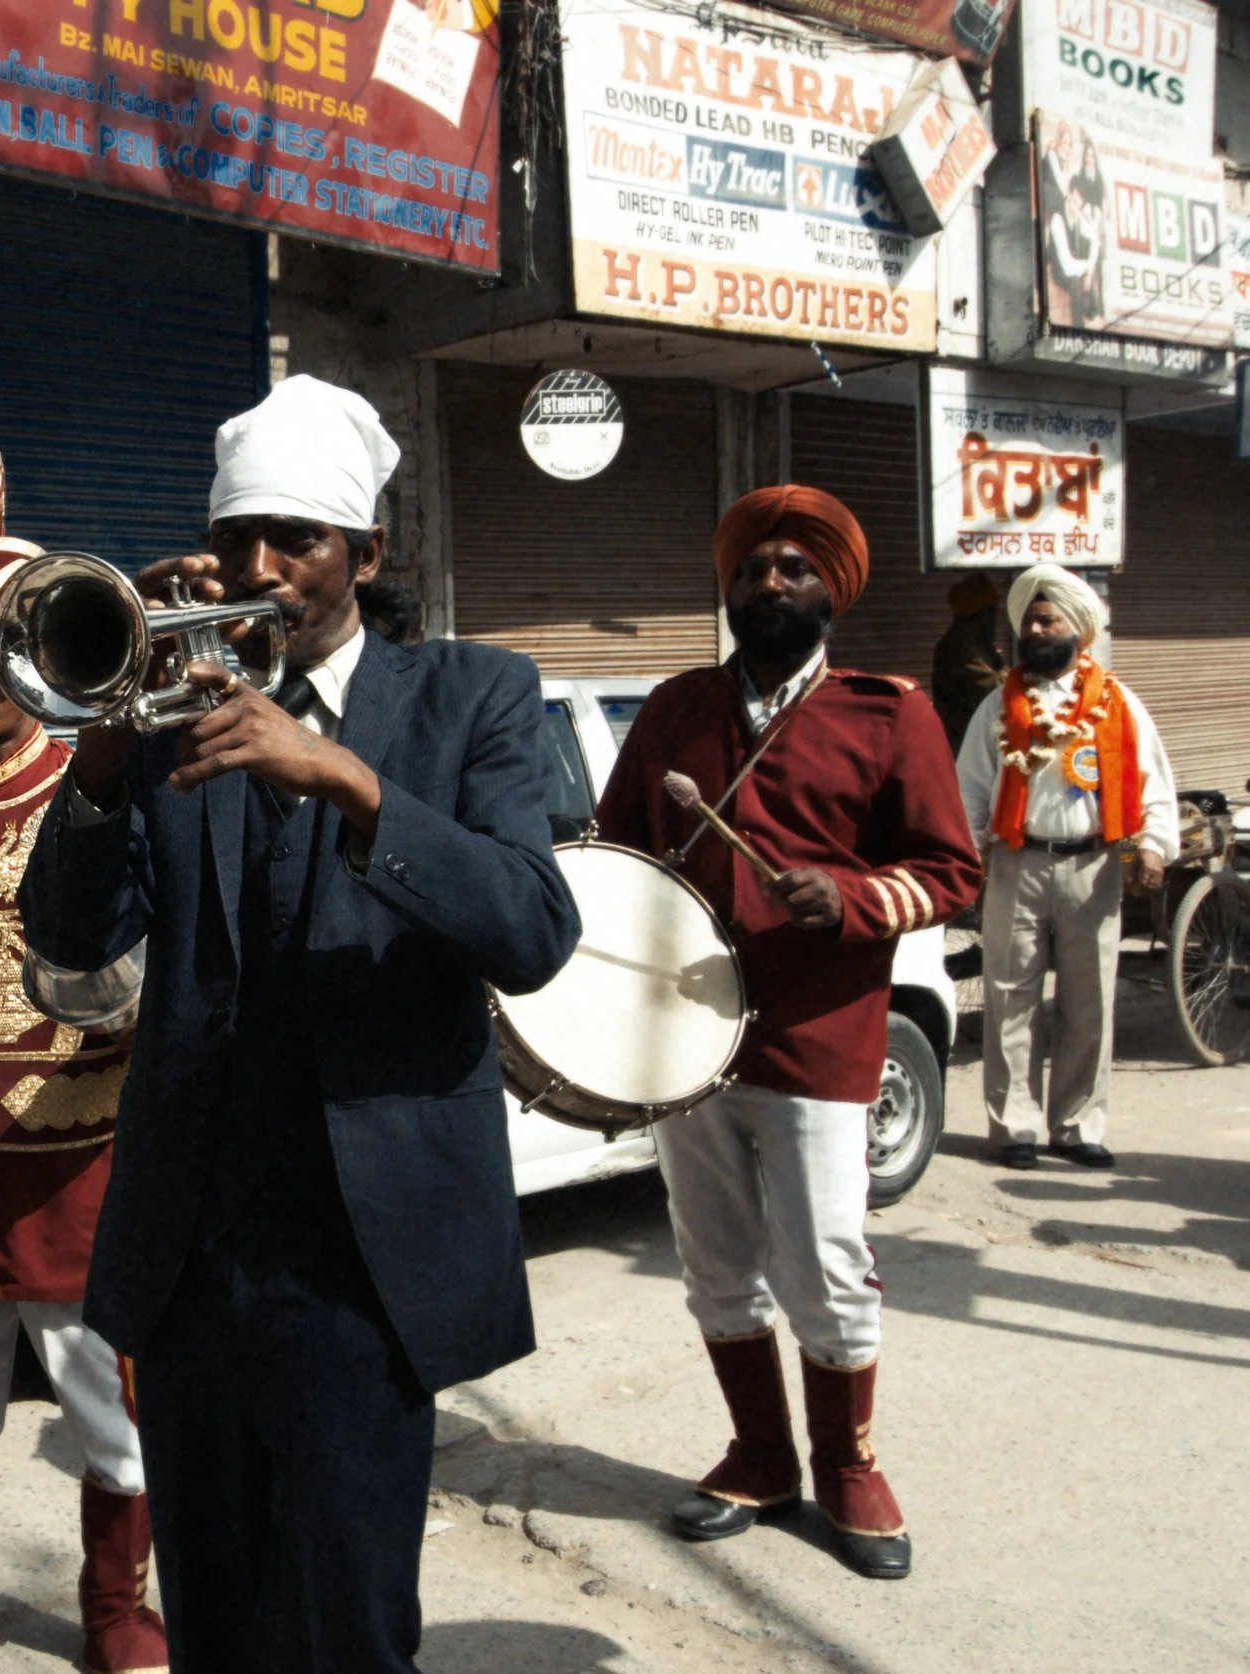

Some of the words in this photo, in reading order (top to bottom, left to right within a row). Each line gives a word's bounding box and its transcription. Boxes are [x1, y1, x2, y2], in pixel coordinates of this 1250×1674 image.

[169, 0, 346, 82] HOUSE
[867, 13, 918, 36] COMPUTER
[1056, 0, 1191, 74] MBD
[103, 33, 145, 66] MAI
[245, 76, 367, 126] AMRITSAR
[1059, 35, 1185, 106] BOOKS
[105, 72, 174, 123] Traders
[178, 95, 201, 127] of
[344, 136, 489, 204] REGISTER
[589, 124, 684, 183] Montex
[605, 87, 688, 124] BONDED
[695, 107, 752, 137] LEAD
[763, 120, 795, 145] HB
[811, 129, 872, 158] PENC
[99, 124, 153, 169] PEN
[177, 144, 308, 206] COMPUTER
[315, 178, 449, 240] STATIONERY
[618, 190, 666, 217] DIRECT
[673, 200, 724, 228] ROLLER
[731, 210, 759, 233] PEN
[826, 169, 900, 222] Lux
[686, 225, 704, 247] INK
[708, 233, 735, 251] PEN
[804, 221, 831, 244] PILOT
[835, 228, 873, 251] HI-TEC
[879, 234, 912, 257] POINT
[1114, 180, 1220, 268] MBD
[814, 250, 843, 269] MICRO
[846, 255, 881, 273] POINT
[882, 260, 903, 277] PEN
[1120, 265, 1223, 305] BOOKS
[714, 270, 910, 336] BROTHERS
[543, 392, 603, 414] steelgrip
